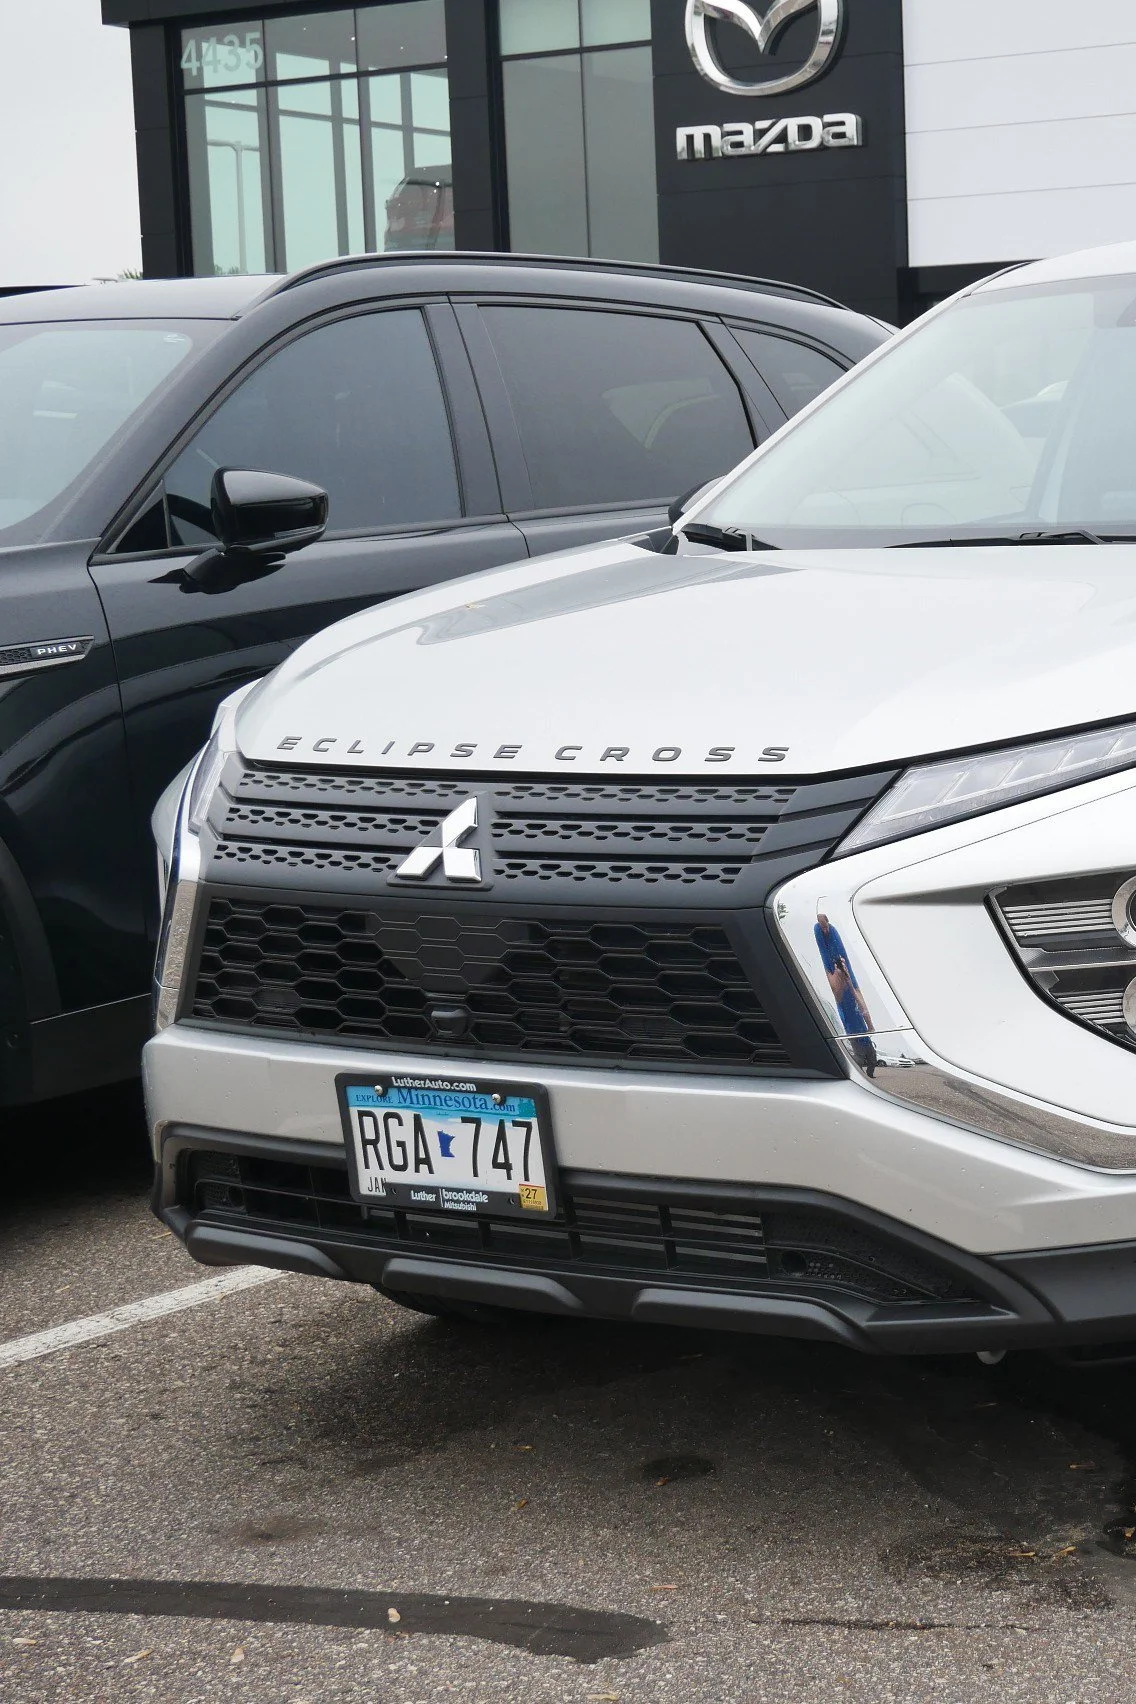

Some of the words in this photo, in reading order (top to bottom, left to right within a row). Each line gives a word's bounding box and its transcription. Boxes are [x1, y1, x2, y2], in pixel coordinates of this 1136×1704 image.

[181, 32, 263, 76] 4435
[676, 112, 862, 160] mazda
[37, 644, 77, 655] PHEV
[276, 736, 523, 760] ECLIPSE
[554, 745, 790, 762] CROSS
[392, 1076, 477, 1092] LutherAuto.com
[355, 1094, 393, 1104] EXPLORE
[397, 1088, 516, 1113] Minnesota.com
[357, 1109, 435, 1175] RGA
[460, 1116, 533, 1182] 747
[410, 1190, 437, 1202] Luther
[442, 1189, 489, 1203] brookdale
[524, 1187, 538, 1200] 27
[444, 1201, 477, 1211] Mitsubishi
